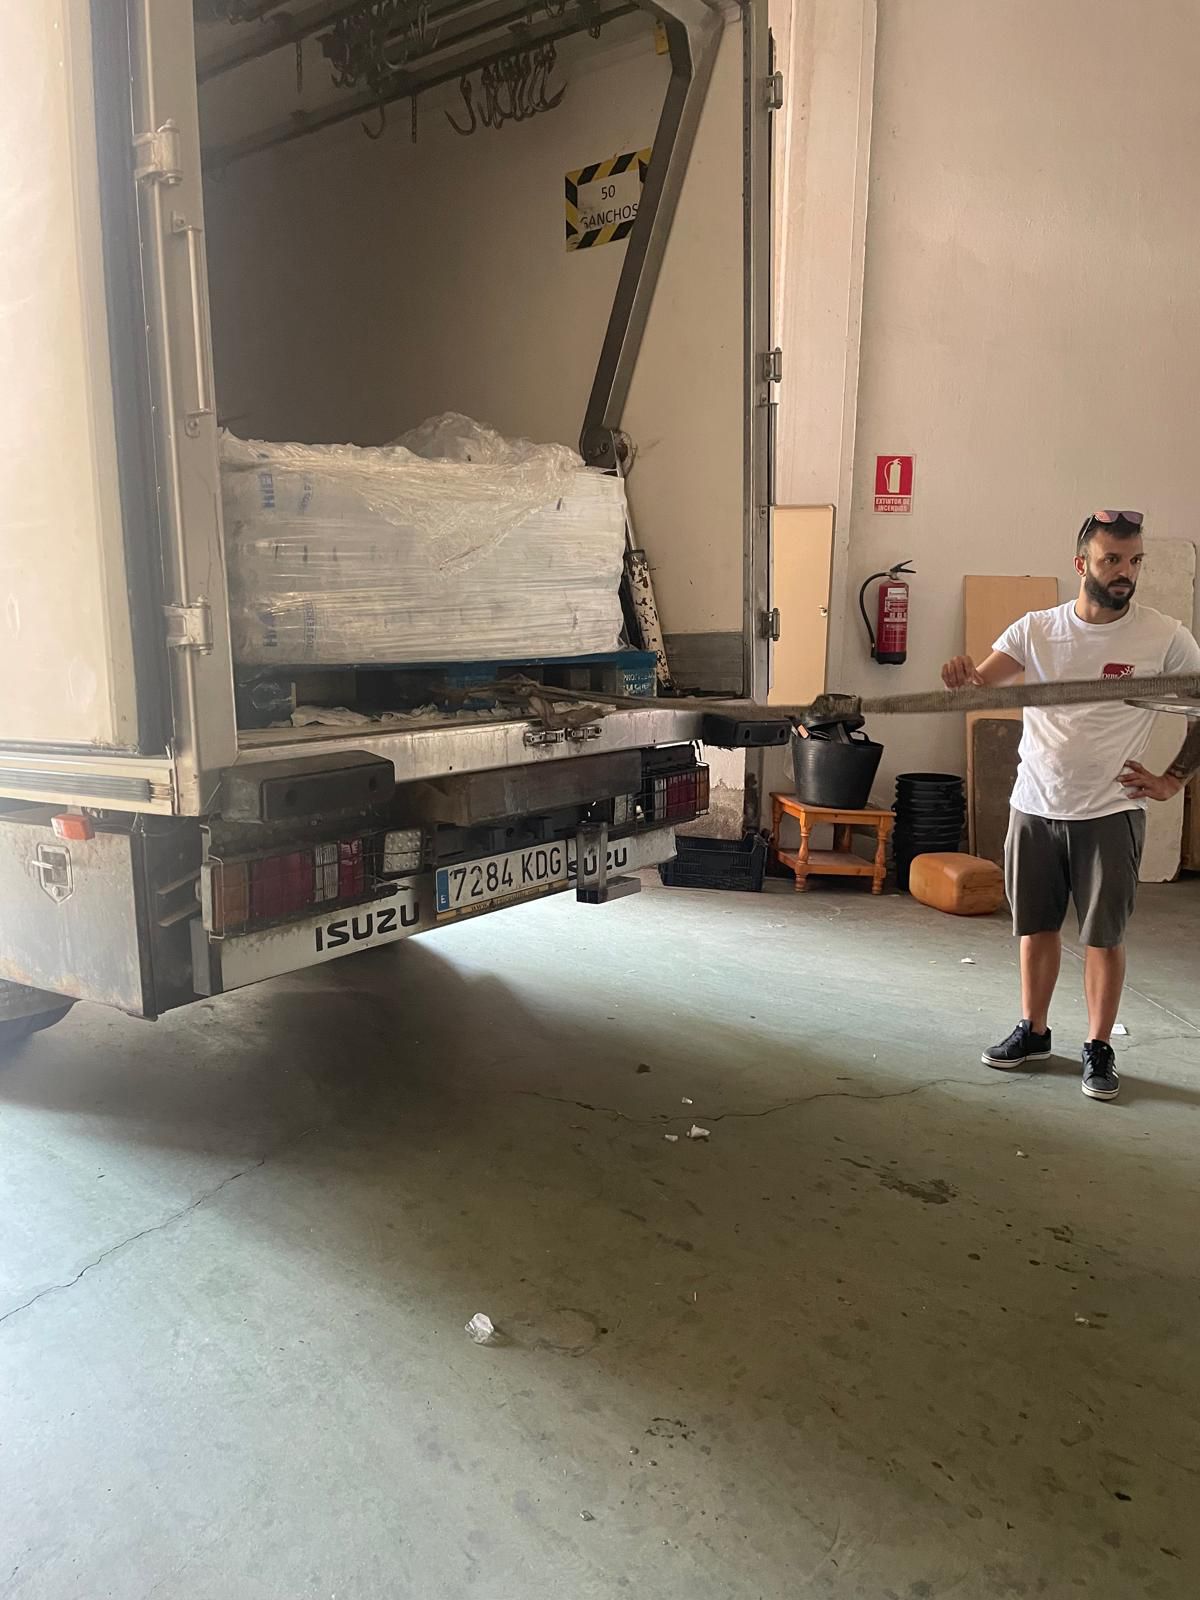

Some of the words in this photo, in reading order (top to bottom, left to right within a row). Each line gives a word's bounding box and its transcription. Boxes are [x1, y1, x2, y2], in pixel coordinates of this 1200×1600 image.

[601, 184, 616, 200] 50
[449, 857, 514, 902] 7284
[521, 846, 561, 884] KDG
[440, 894, 447, 904] E
[315, 902, 420, 952] ISUZU
